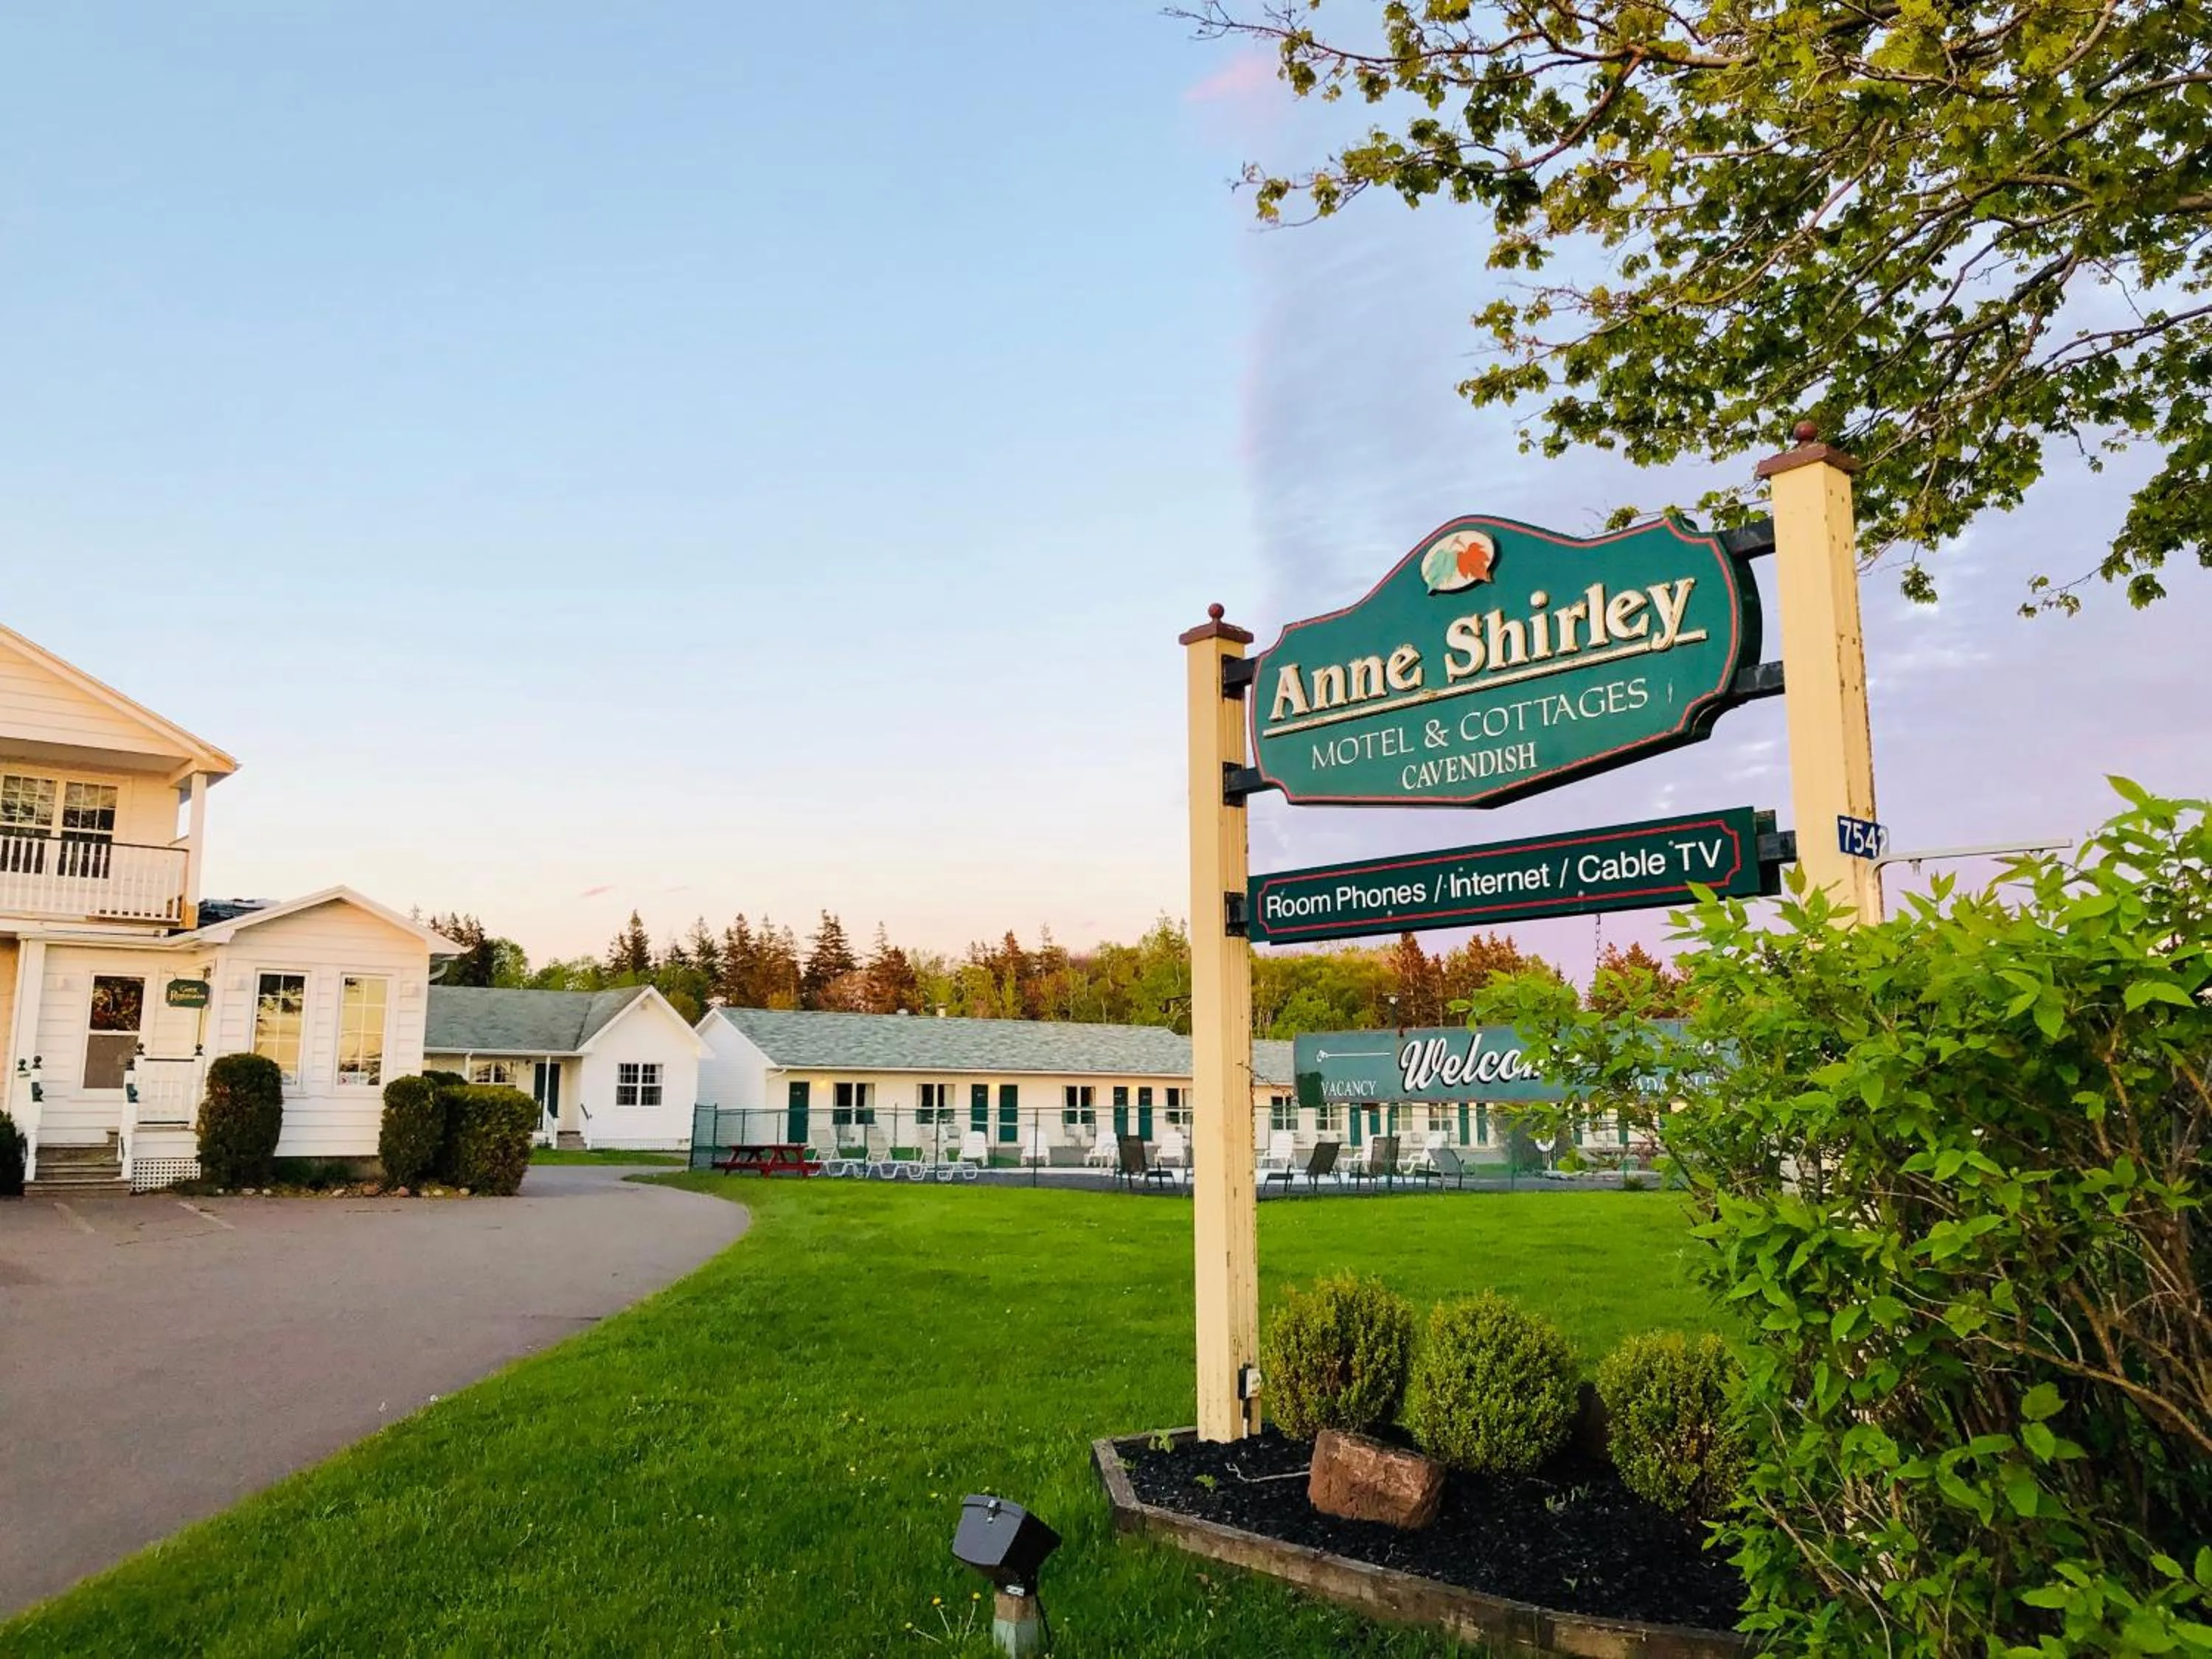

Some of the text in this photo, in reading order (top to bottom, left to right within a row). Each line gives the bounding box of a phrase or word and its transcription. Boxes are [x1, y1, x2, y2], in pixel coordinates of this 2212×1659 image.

[1269, 577, 1697, 722] Anne Shirley
[1310, 677, 1649, 770] MOTEL & COTTAGES
[1402, 742, 1538, 790] CAVENDISH
[1266, 894, 1331, 919] Room
[1336, 882, 1427, 911] Phones
[1450, 868, 1551, 898] Internet
[1577, 849, 1666, 884] Cable
[1674, 839, 1723, 874] TV
[1321, 1080, 1377, 1097] VACANCY
